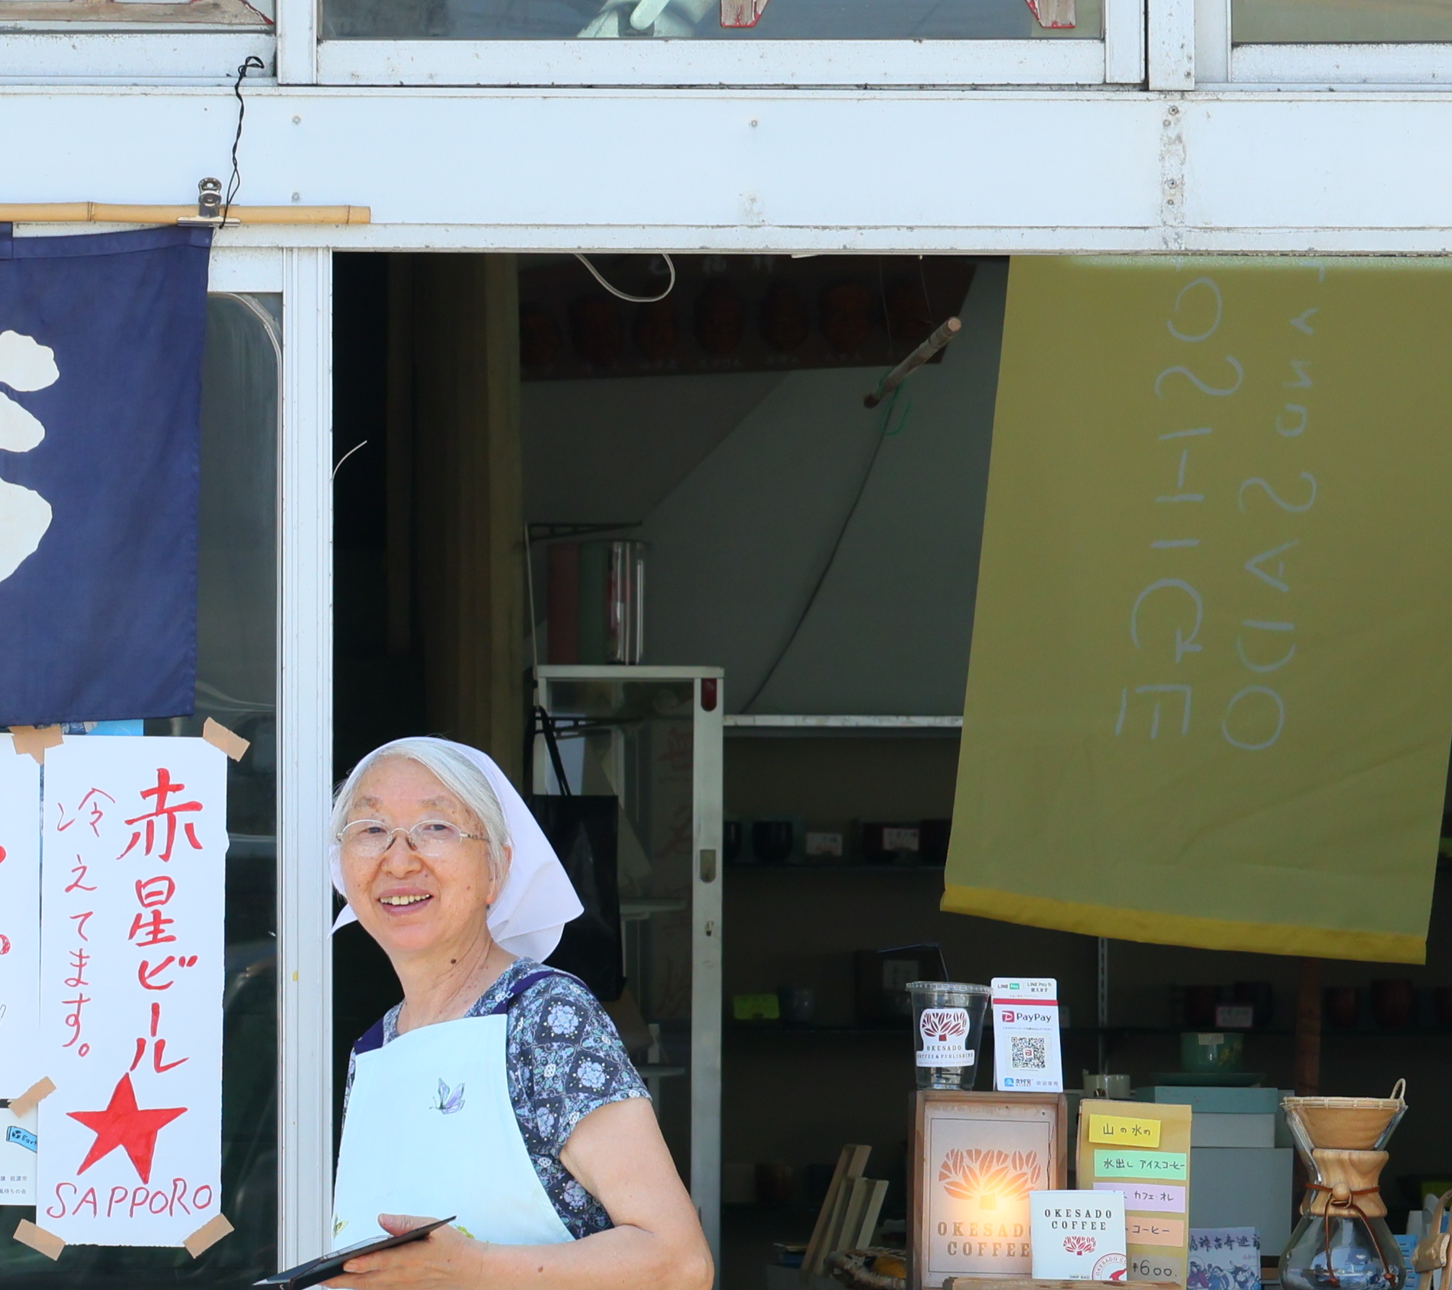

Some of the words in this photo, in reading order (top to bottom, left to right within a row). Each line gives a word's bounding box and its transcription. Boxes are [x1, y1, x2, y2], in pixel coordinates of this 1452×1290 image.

[117, 767, 203, 1075] 赤星ビール
[1016, 1012, 1052, 1023] PayPay
[1104, 1158, 1133, 1169] 水出し
[46, 1178, 213, 1219] SAPPORO
[1044, 1209, 1112, 1219] OKESADO
[937, 1221, 1031, 1238] OKESAD
[1051, 1221, 1107, 1230] COFFEE
